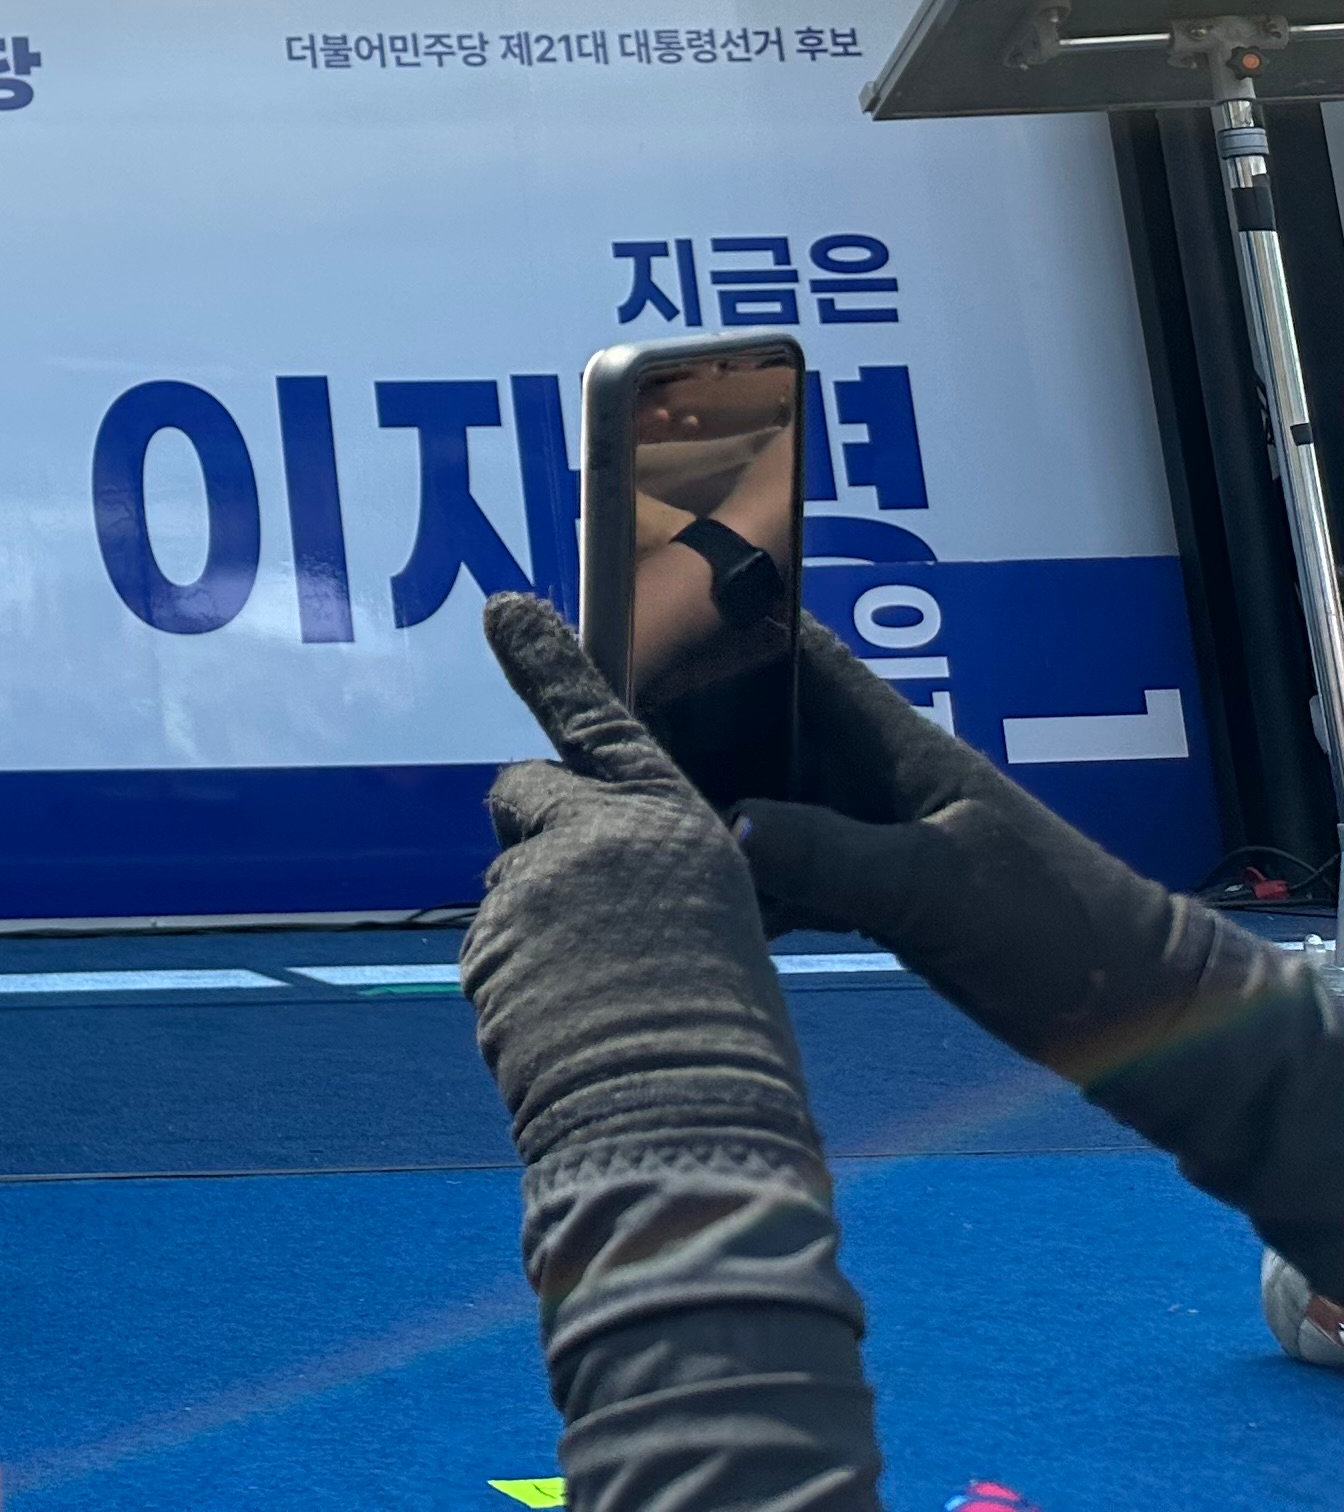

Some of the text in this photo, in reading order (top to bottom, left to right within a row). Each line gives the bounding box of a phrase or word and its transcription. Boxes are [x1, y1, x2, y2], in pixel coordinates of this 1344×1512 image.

[285, 26, 863, 70] 더불어민주당 제21대 대통령선거 후보
[612, 233, 900, 328] 지금은
